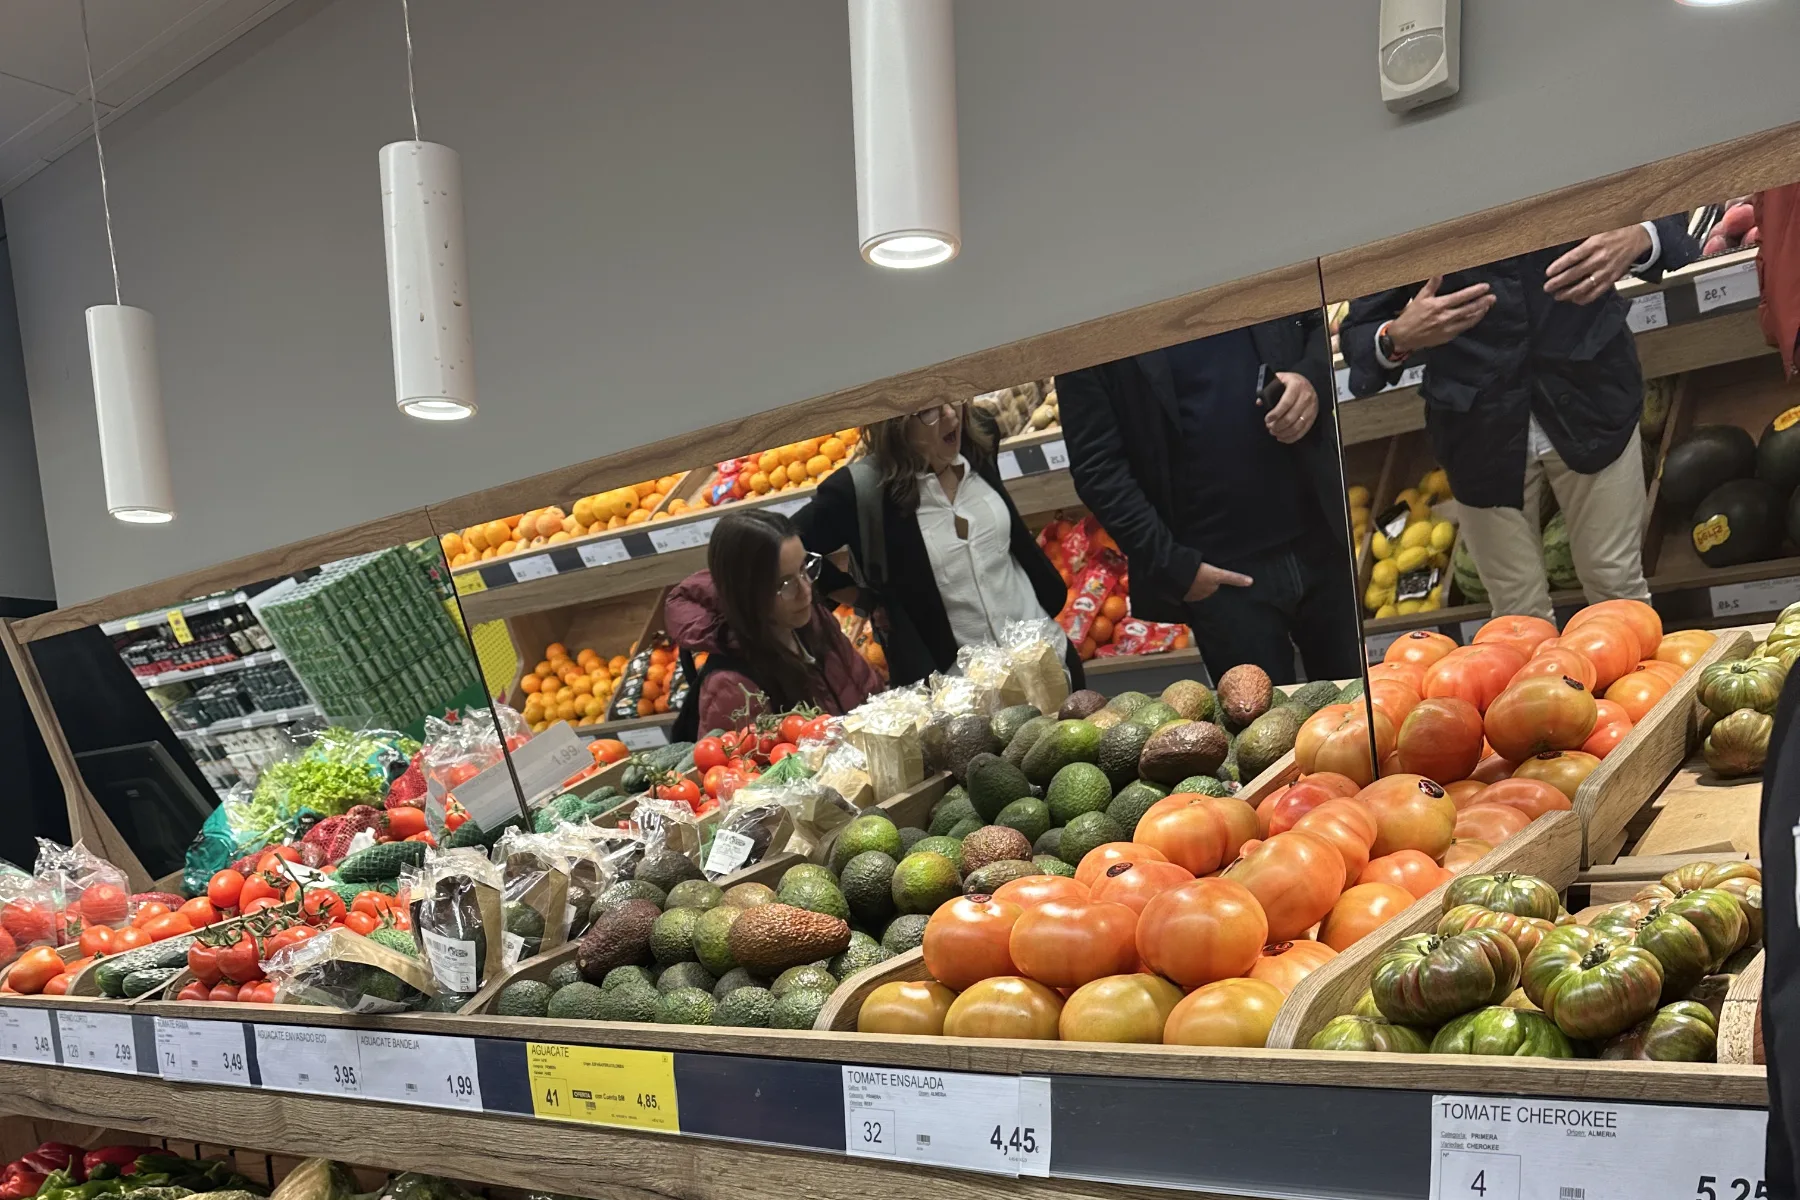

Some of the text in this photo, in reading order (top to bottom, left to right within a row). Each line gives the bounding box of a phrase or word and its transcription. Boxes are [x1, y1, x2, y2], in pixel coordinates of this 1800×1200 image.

[257, 1030, 285, 1042] AGUACATE
[361, 1036, 420, 1050] AGUACATE BANDEJA
[531, 1045, 569, 1058] AGUACATE
[165, 1052, 175, 1067] 74
[847, 1070, 944, 1091] TOMATE ENSALADA
[546, 1088, 559, 1107] 41
[1441, 1103, 1618, 1129] TOMATE CHEROKEE
[863, 1121, 882, 1144] 32
[1471, 1132, 1498, 1141] PRIMERA
[1467, 1143, 1499, 1151] CHEROKEE
[1471, 1169, 1487, 1198] 4
